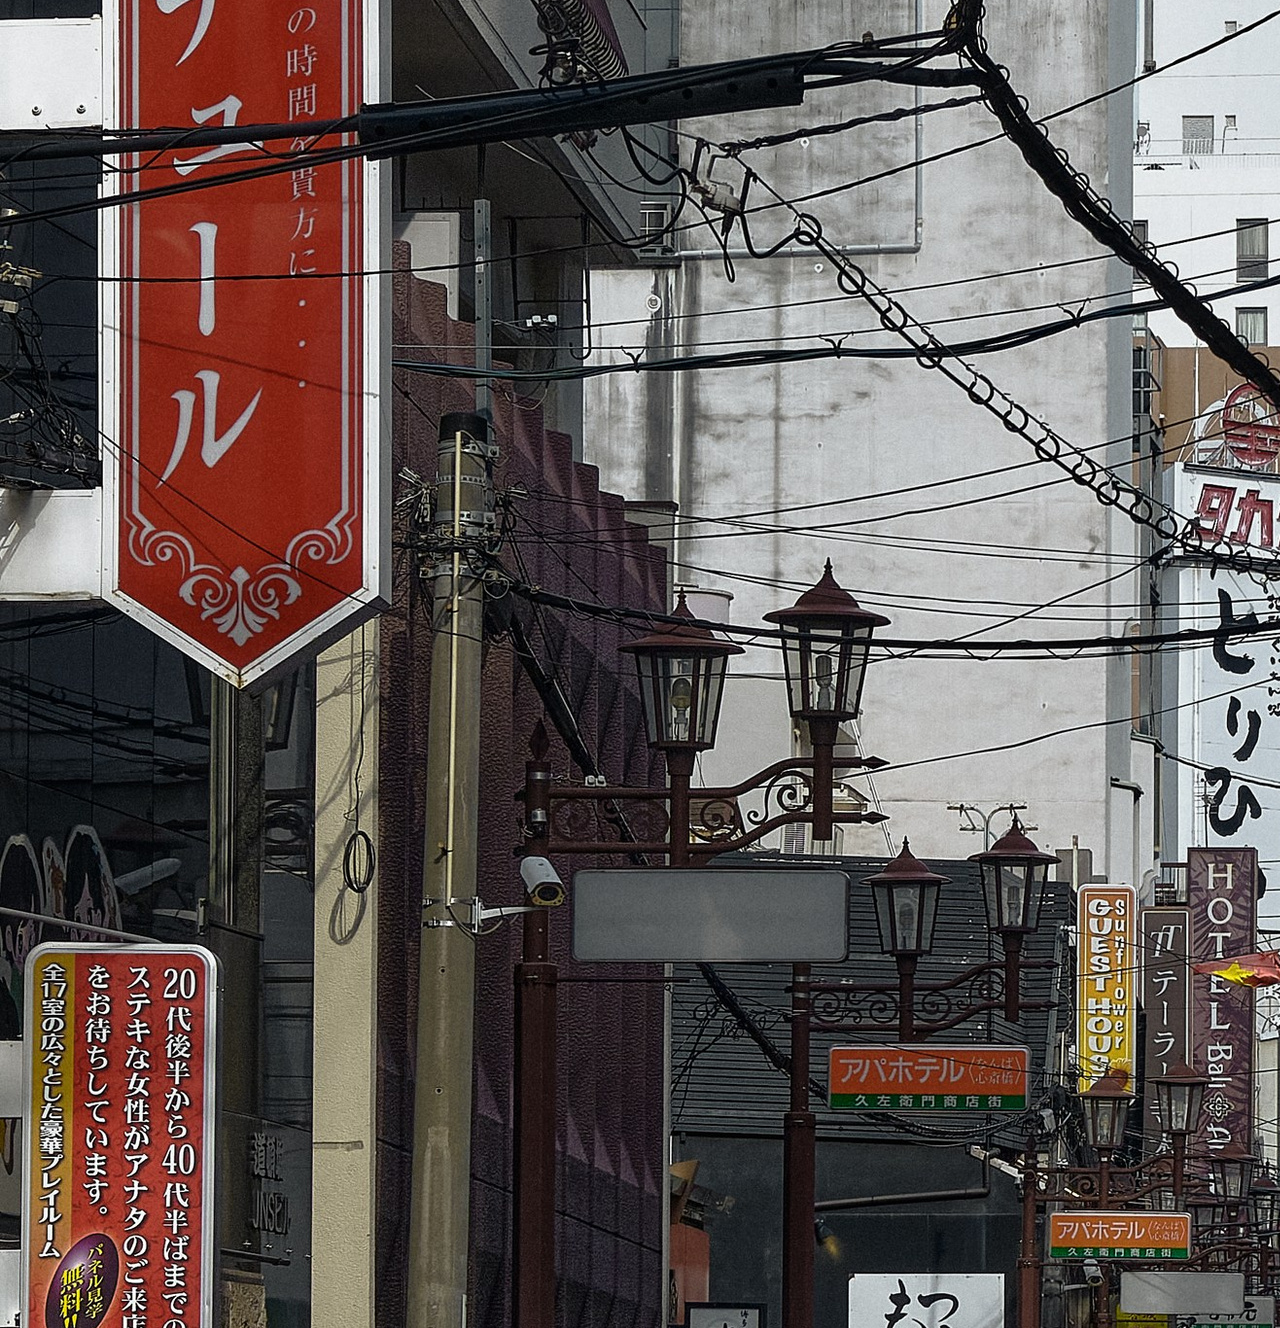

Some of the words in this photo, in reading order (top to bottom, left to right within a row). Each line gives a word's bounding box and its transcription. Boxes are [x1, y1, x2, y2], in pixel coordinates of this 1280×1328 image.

[1203, 586, 1266, 901] とりひ
[1088, 898, 1114, 993] GUEST
[1113, 899, 1127, 1050] Sunflower
[838, 1056, 966, 1085] アパホテル
[1088, 997, 1114, 1085] HOUS
[1206, 1044, 1233, 1089] Bali
[38, 962, 66, 1260] 全17室の広々とした豪華プレイルーム
[84, 964, 111, 1217] をお待ちしています。
[854, 1094, 1003, 1108] 久左衛門商店街
[1056, 1220, 1145, 1242] アパホテル
[1067, 1247, 1172, 1257] 久左衛門商店街
[84, 1242, 104, 1320] パネル見学
